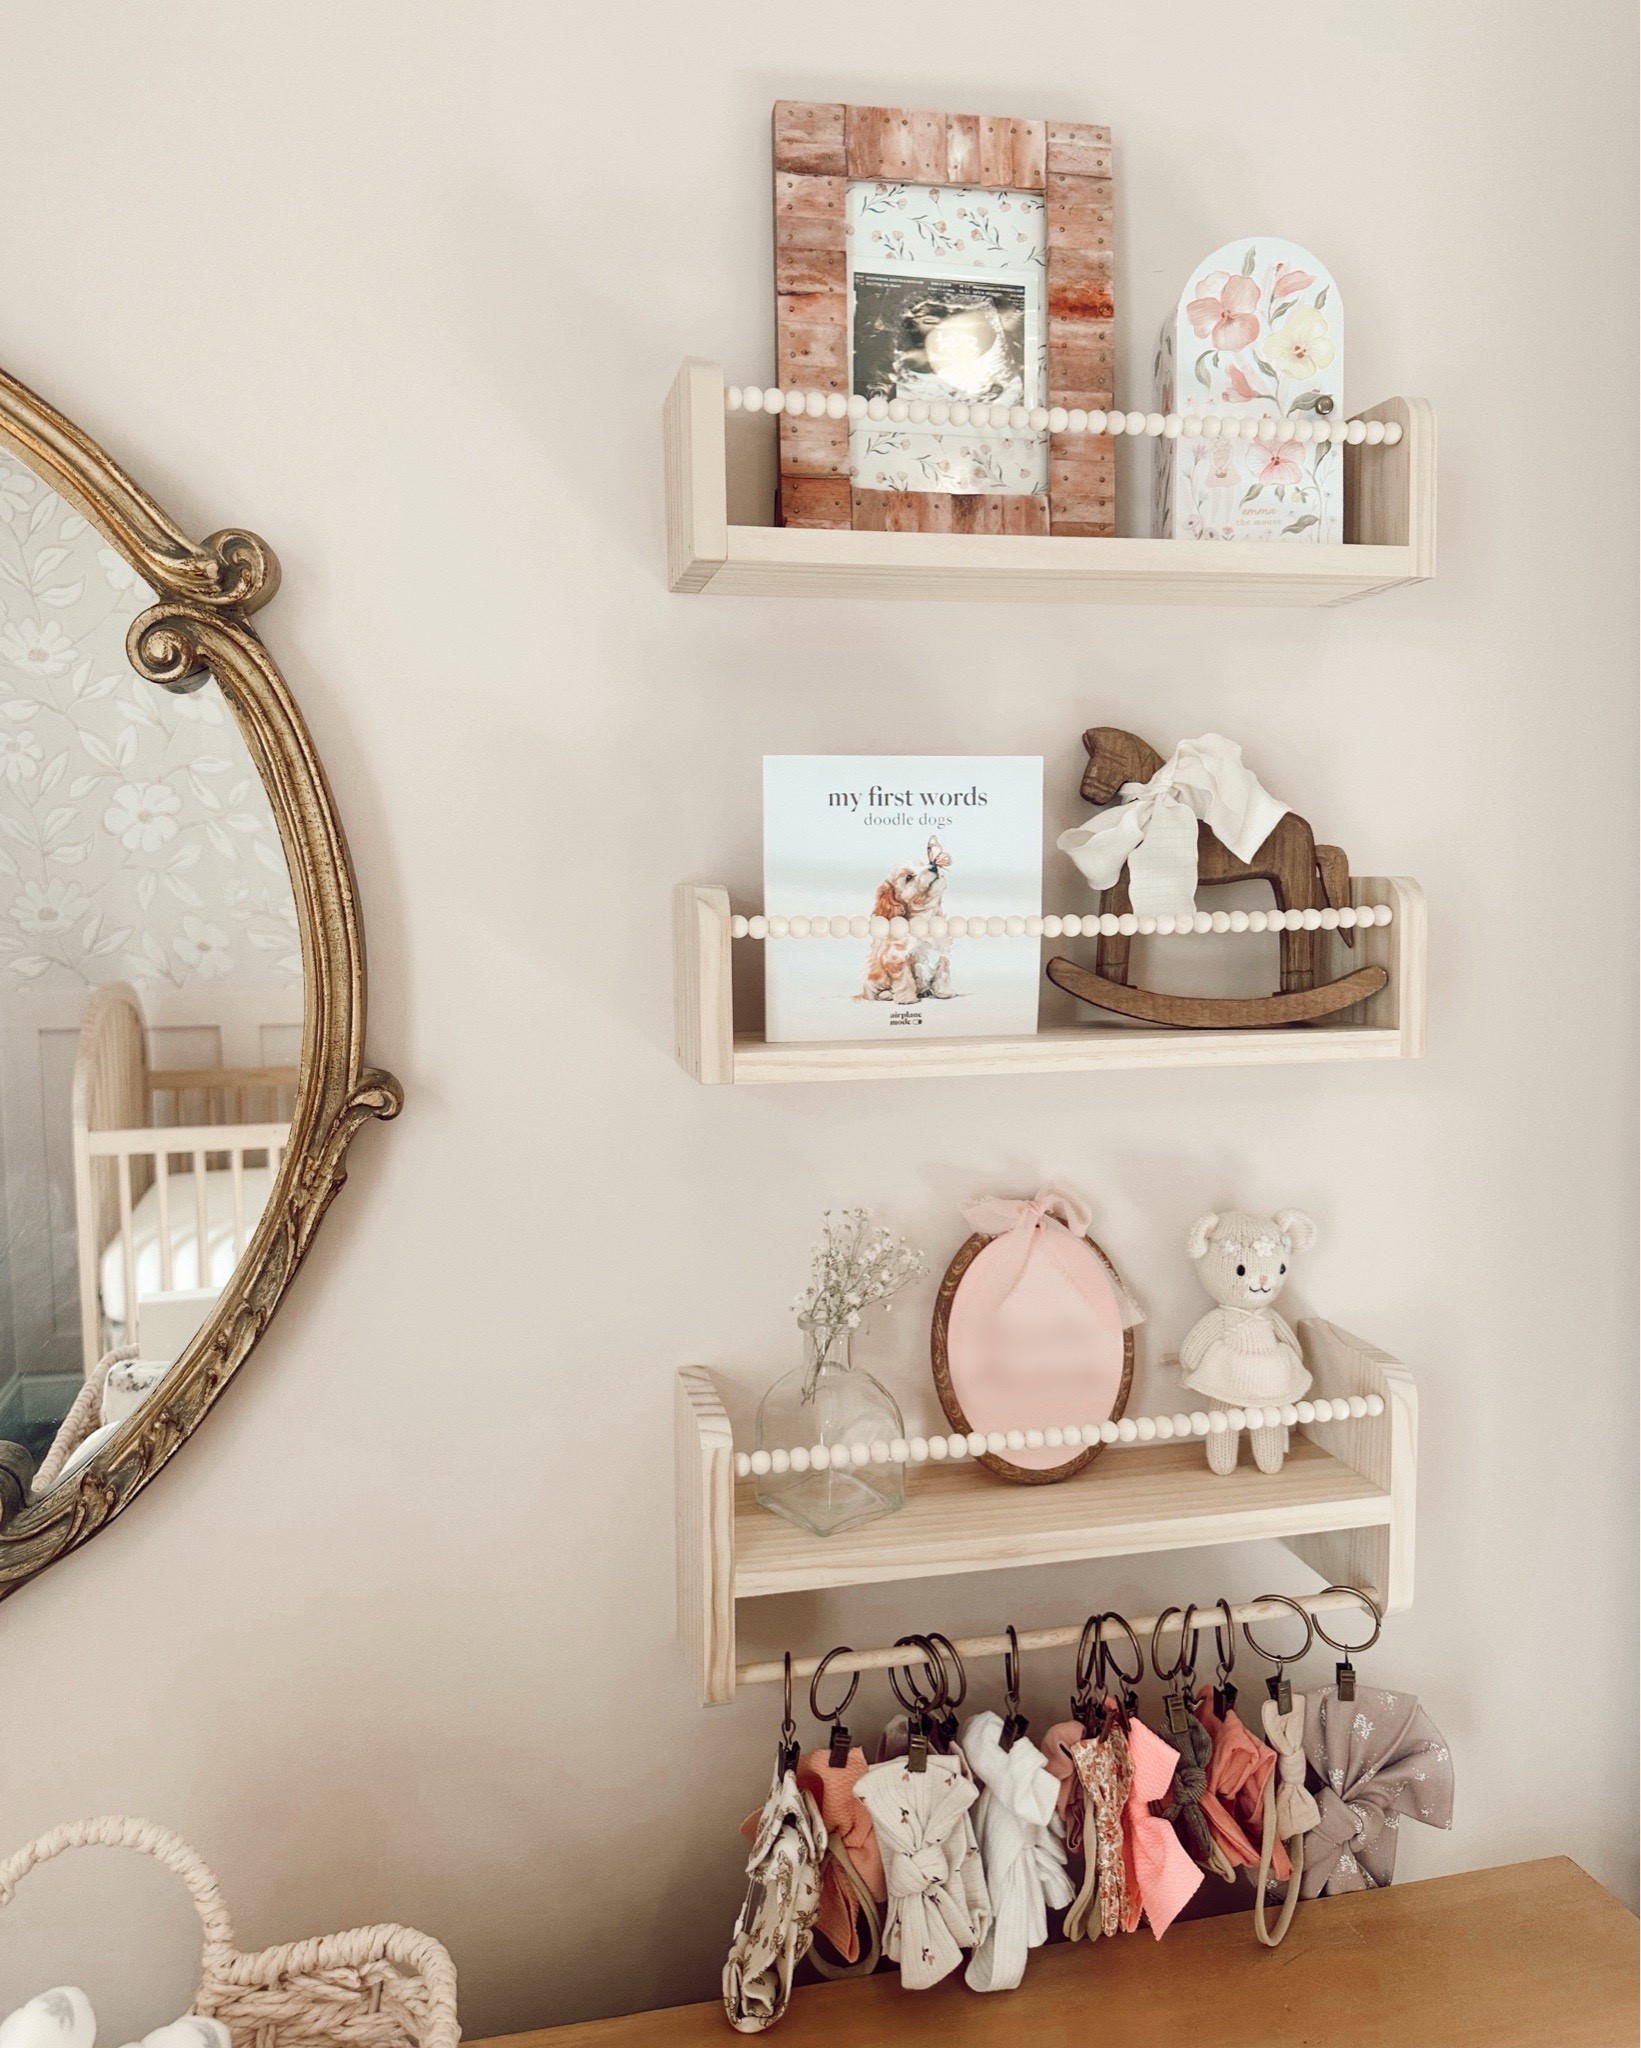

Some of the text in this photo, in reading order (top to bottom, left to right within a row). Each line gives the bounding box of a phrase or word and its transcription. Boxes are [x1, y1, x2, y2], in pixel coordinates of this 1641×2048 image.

[828, 785, 988, 812] my first words
[864, 813, 953, 830] doodle dogs
[890, 1011, 922, 1020] airplane
[890, 1018, 911, 1026] mode
